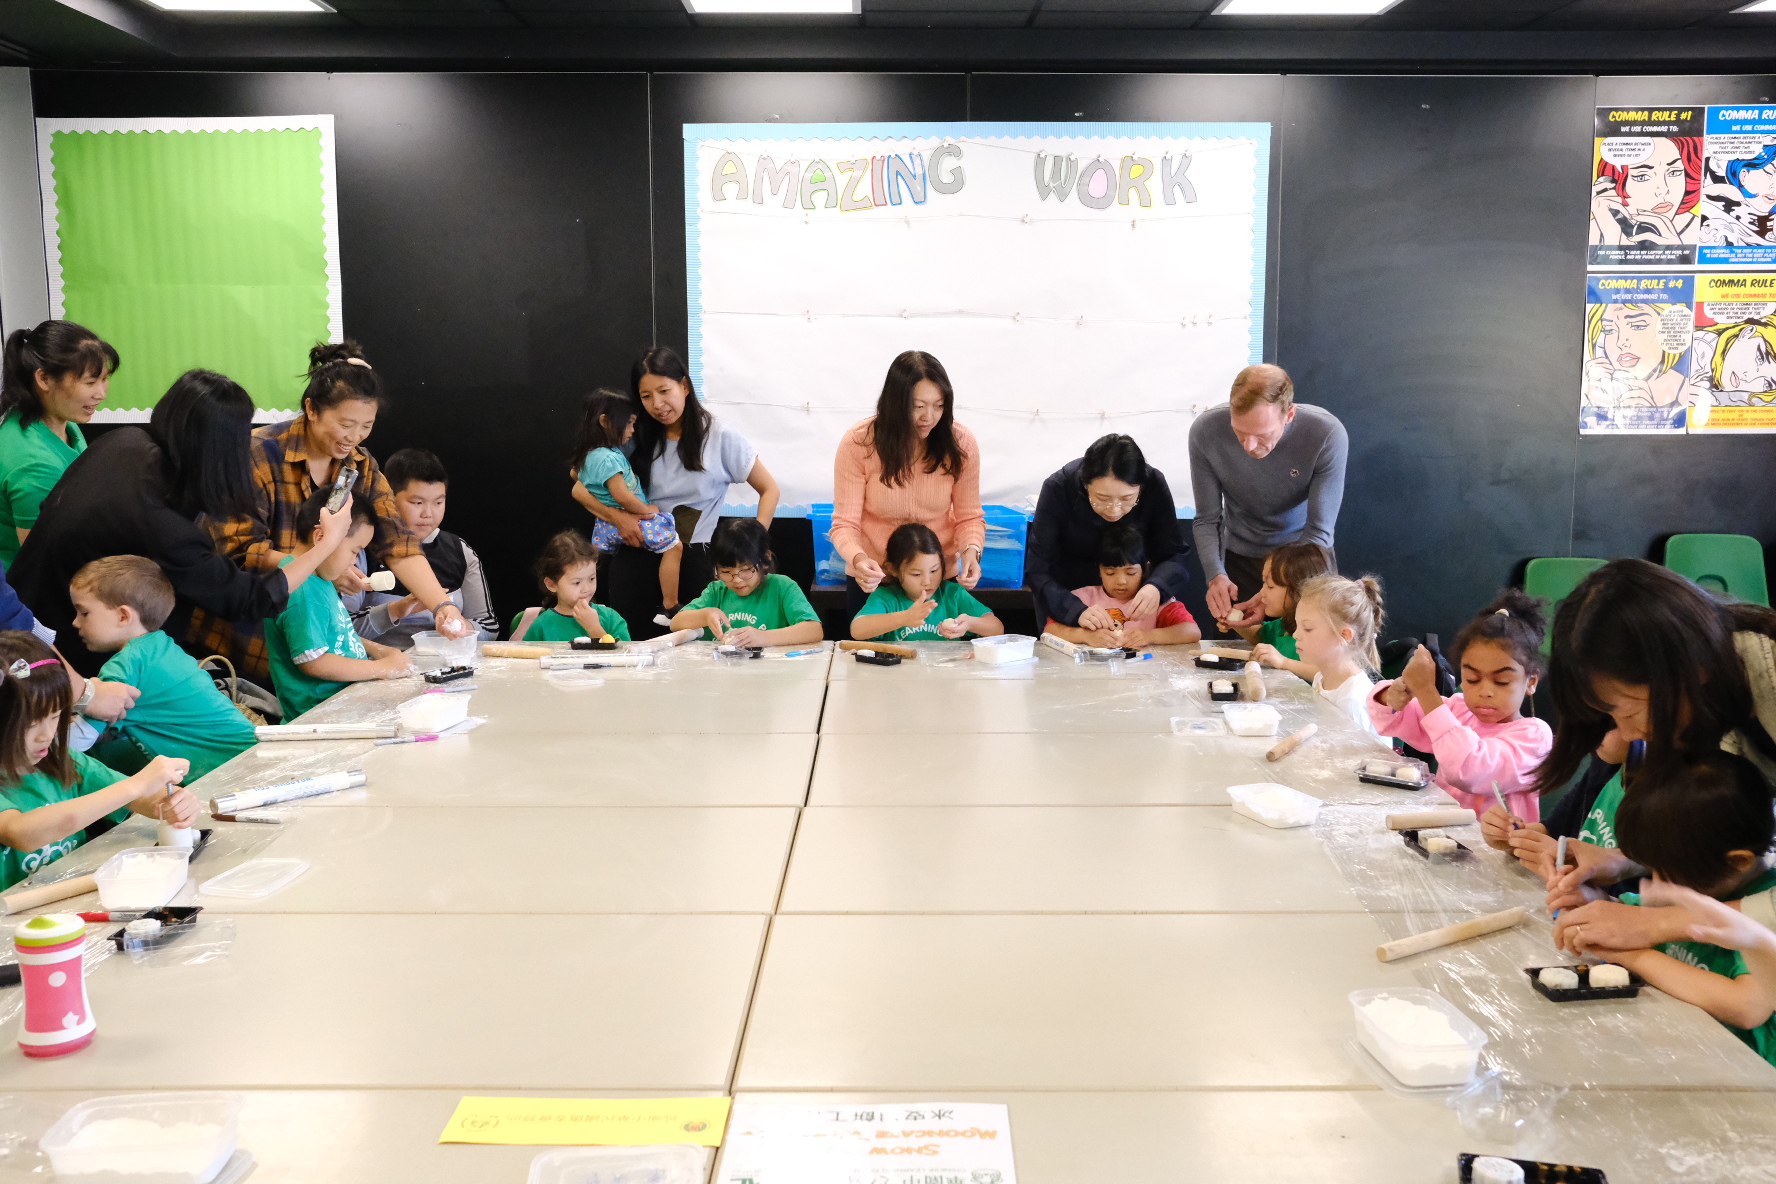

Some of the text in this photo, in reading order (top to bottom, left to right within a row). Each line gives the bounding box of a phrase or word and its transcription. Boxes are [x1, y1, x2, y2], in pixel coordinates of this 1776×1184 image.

[1609, 110, 1692, 121] COMMA RULE #1
[1719, 110, 1759, 120] COMMA
[712, 143, 1198, 212] AMAZING WORK
[1598, 279, 1684, 289] COMMA RULE #4
[1709, 279, 1776, 288] COMMA RULE
[868, 1143, 941, 1156] SNOW
